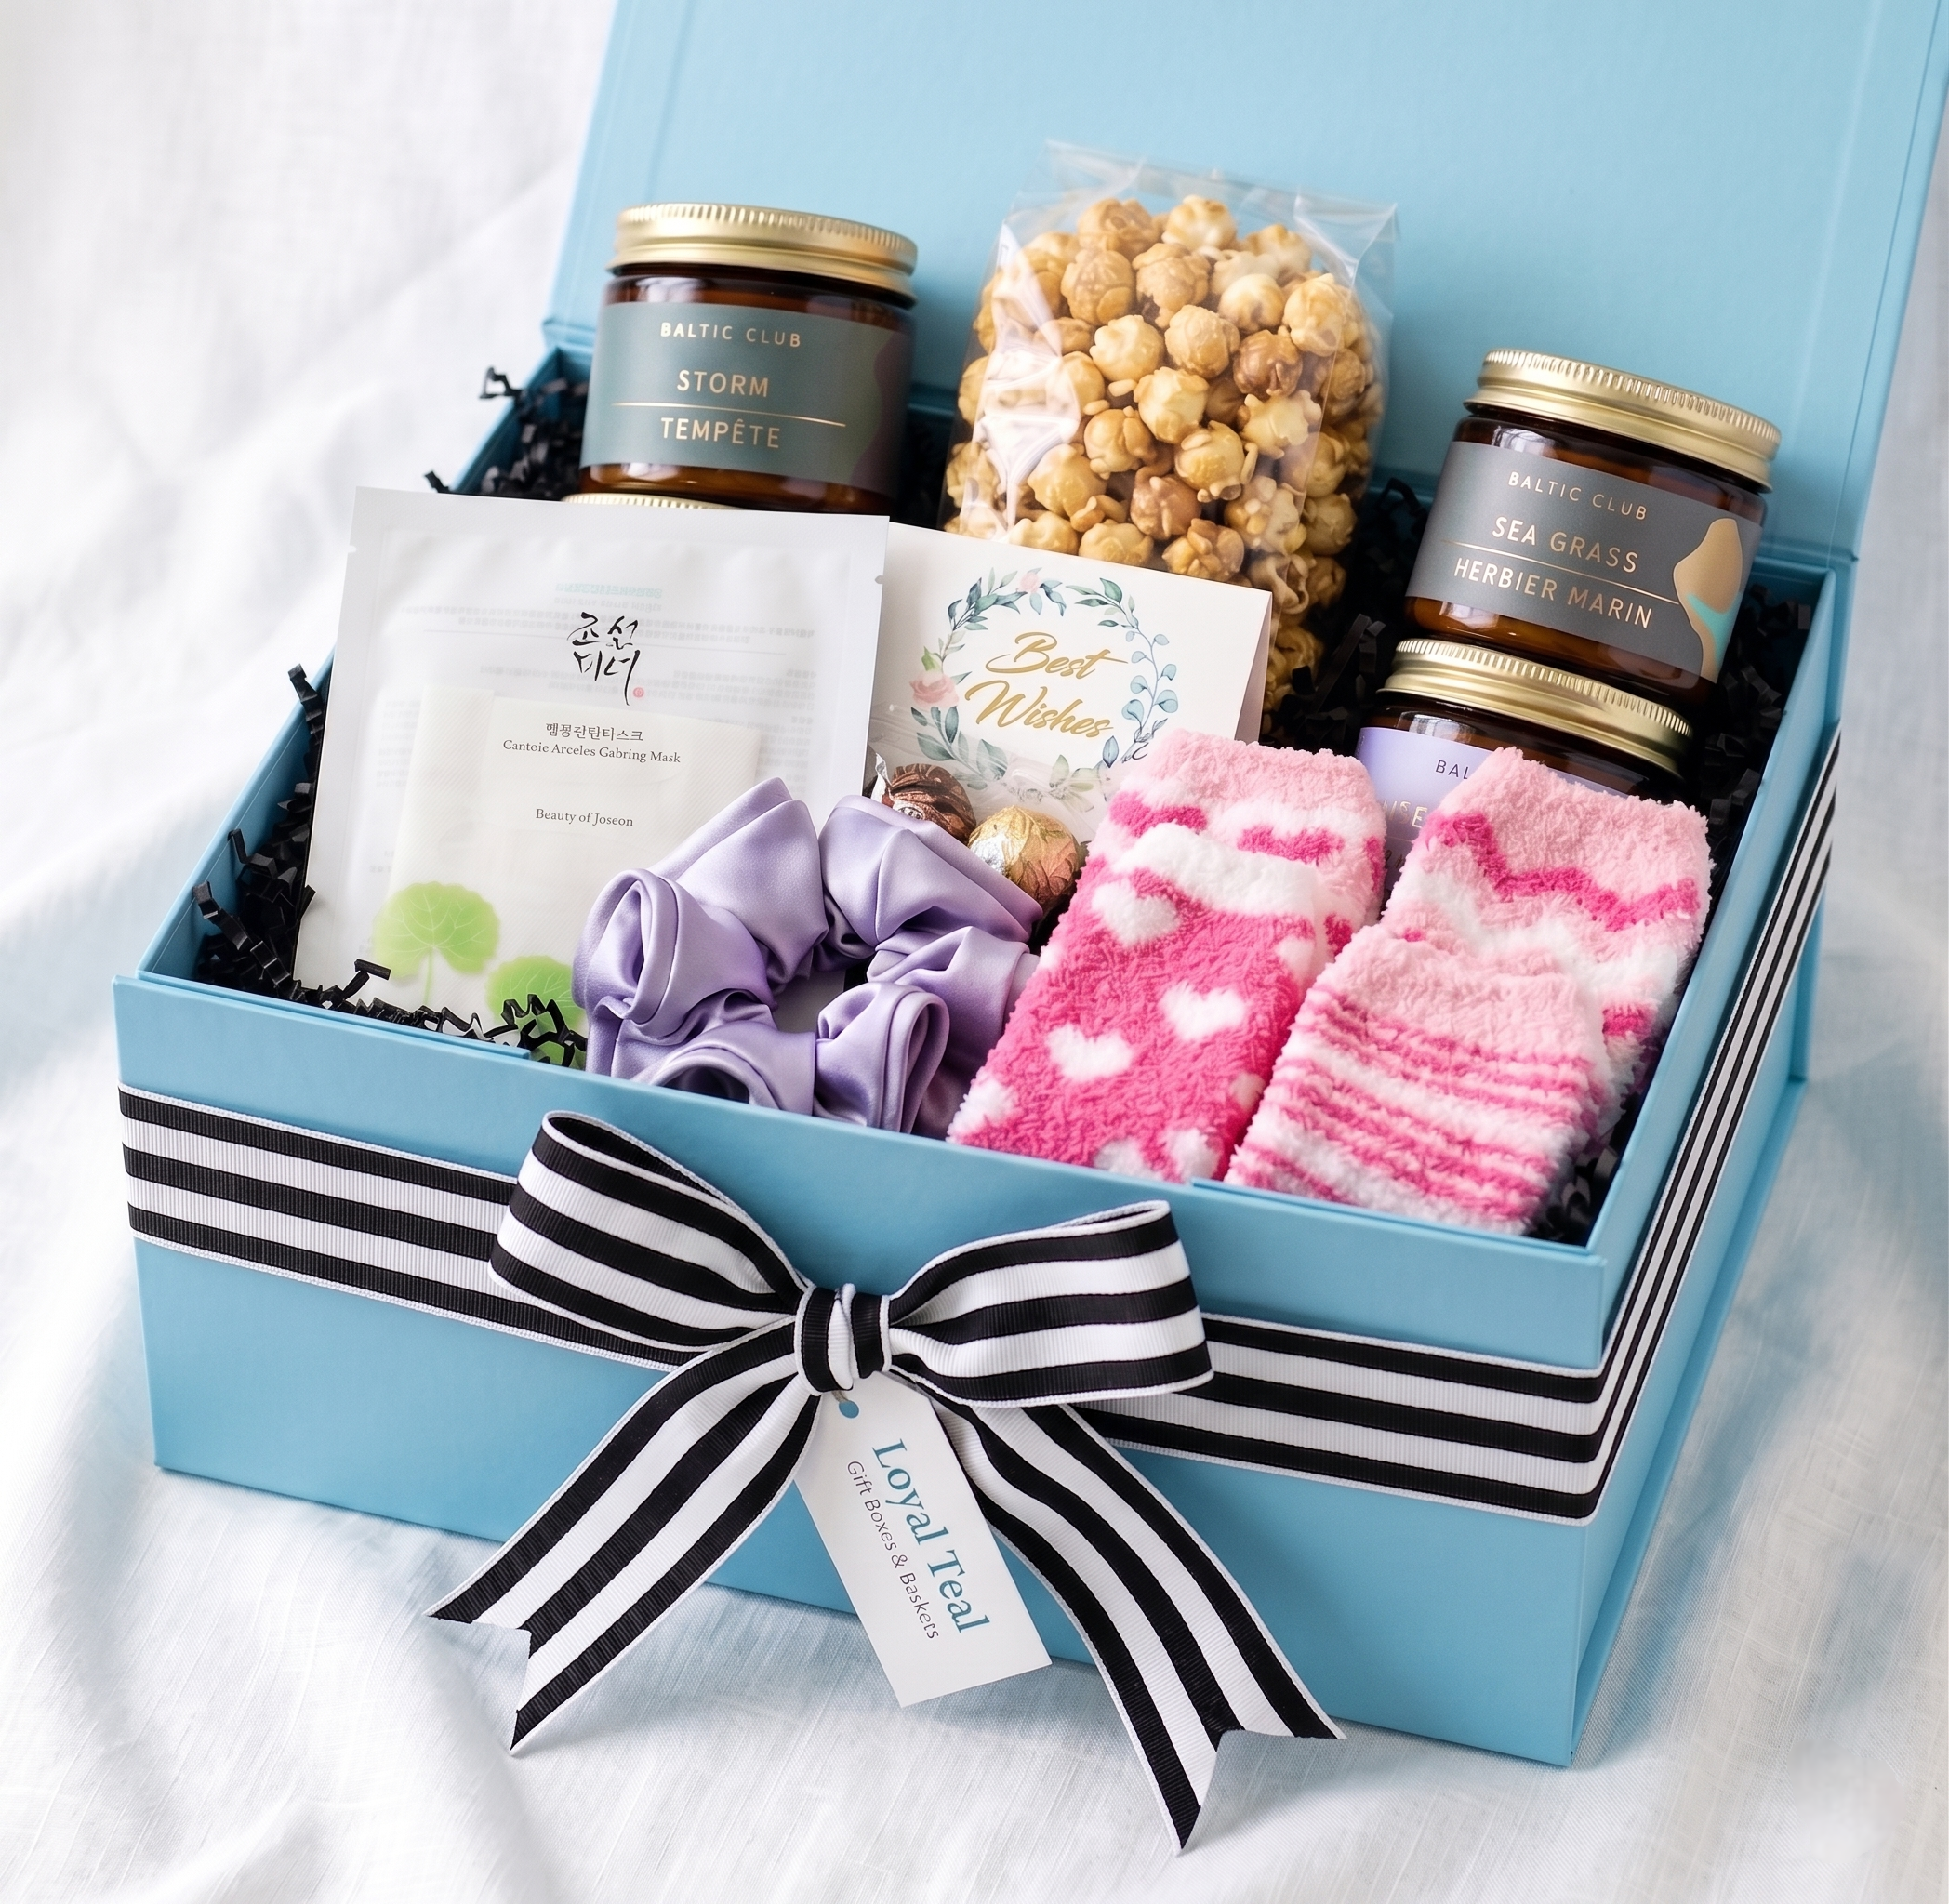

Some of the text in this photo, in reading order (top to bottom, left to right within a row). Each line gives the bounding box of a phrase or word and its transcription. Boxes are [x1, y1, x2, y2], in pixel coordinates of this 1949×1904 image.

[660, 322, 801, 348] BALTIC CLUB
[677, 369, 769, 398] STORM
[660, 416, 780, 449] TEMPÊTE
[1508, 471, 1648, 522] BALTIC CLUB
[1492, 516, 1638, 574] SEA GRASS
[1453, 557, 1652, 629] HERBIER MARIN
[985, 631, 1129, 680] Best
[964, 679, 1114, 738] Wishes
[599, 747, 647, 763] Gabring
[649, 751, 681, 763] Mask
[536, 808, 634, 826] Beauty of Joseon
[847, 1461, 939, 1639] Gift Boxes & Baskets
[871, 1438, 990, 1633] Loyal Teal
